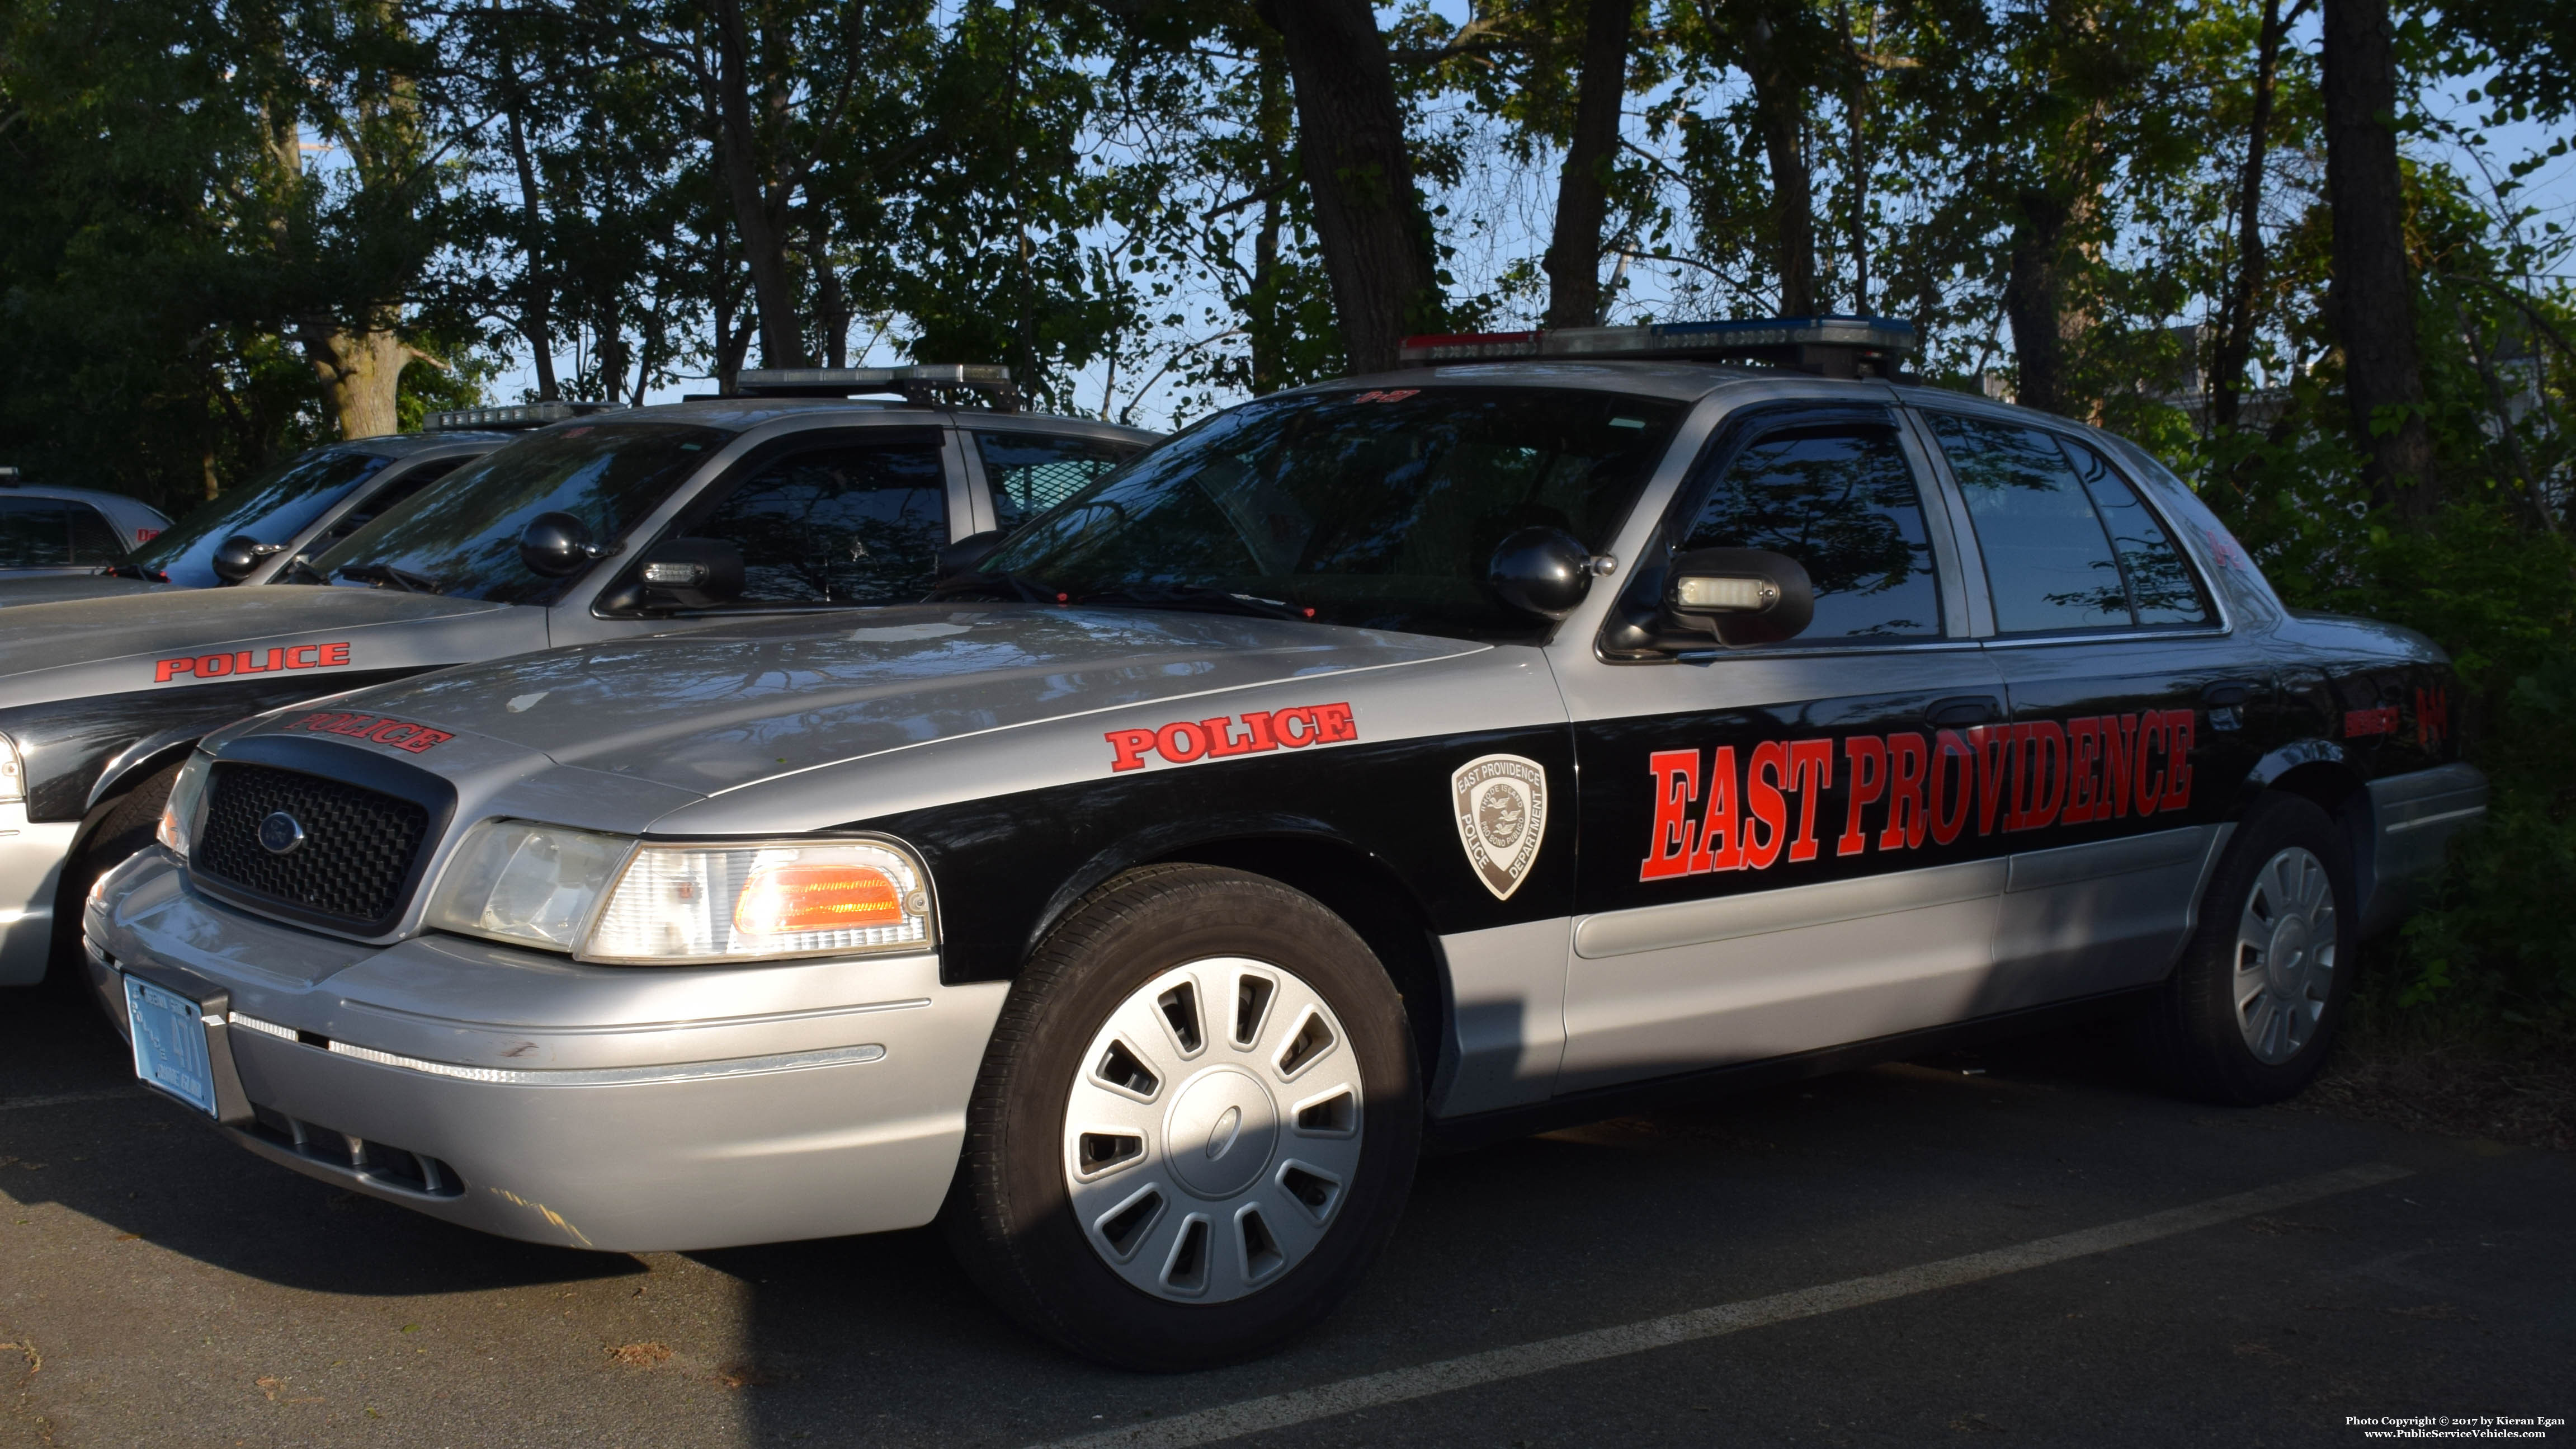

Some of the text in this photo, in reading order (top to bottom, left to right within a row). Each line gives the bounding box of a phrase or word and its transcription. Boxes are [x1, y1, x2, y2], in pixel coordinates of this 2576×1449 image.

[154, 642, 351, 683] POLICE
[284, 712, 456, 754] POLICE
[1104, 702, 1358, 773] POLICE
[1457, 761, 1540, 794] EAST PROVIDENCE
[1480, 784, 1523, 812] RHODE ISLAND
[1639, 709, 2195, 882] EAST PROVIDENCE
[1462, 791, 1542, 879] POLICE DEPARTMENT
[1480, 817, 1524, 848] PRO BONO PUBLICO
